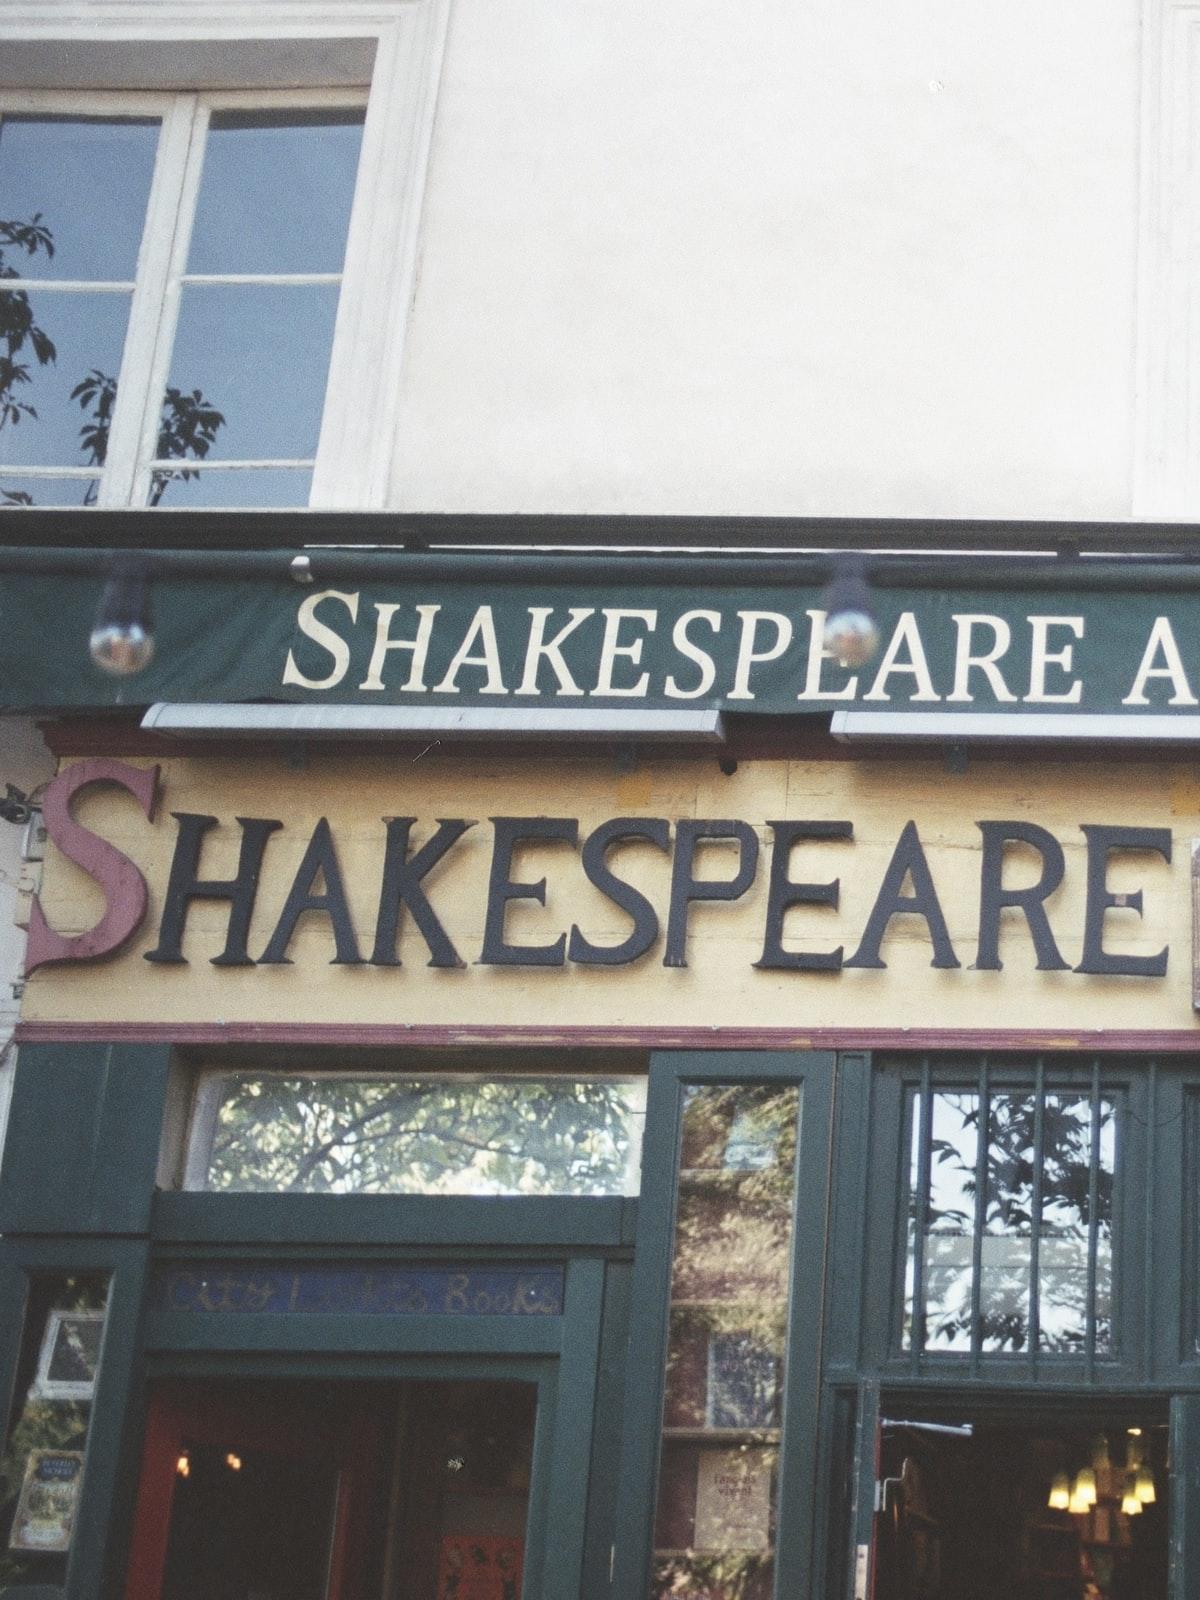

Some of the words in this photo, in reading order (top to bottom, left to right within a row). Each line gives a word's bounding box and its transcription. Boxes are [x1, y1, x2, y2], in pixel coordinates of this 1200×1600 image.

[283, 589, 1084, 705] SHAKESPEARE
[24, 757, 1172, 980] SHAKESPEARE
[168, 1272, 274, 1313] City
[444, 1271, 562, 1314] Books
